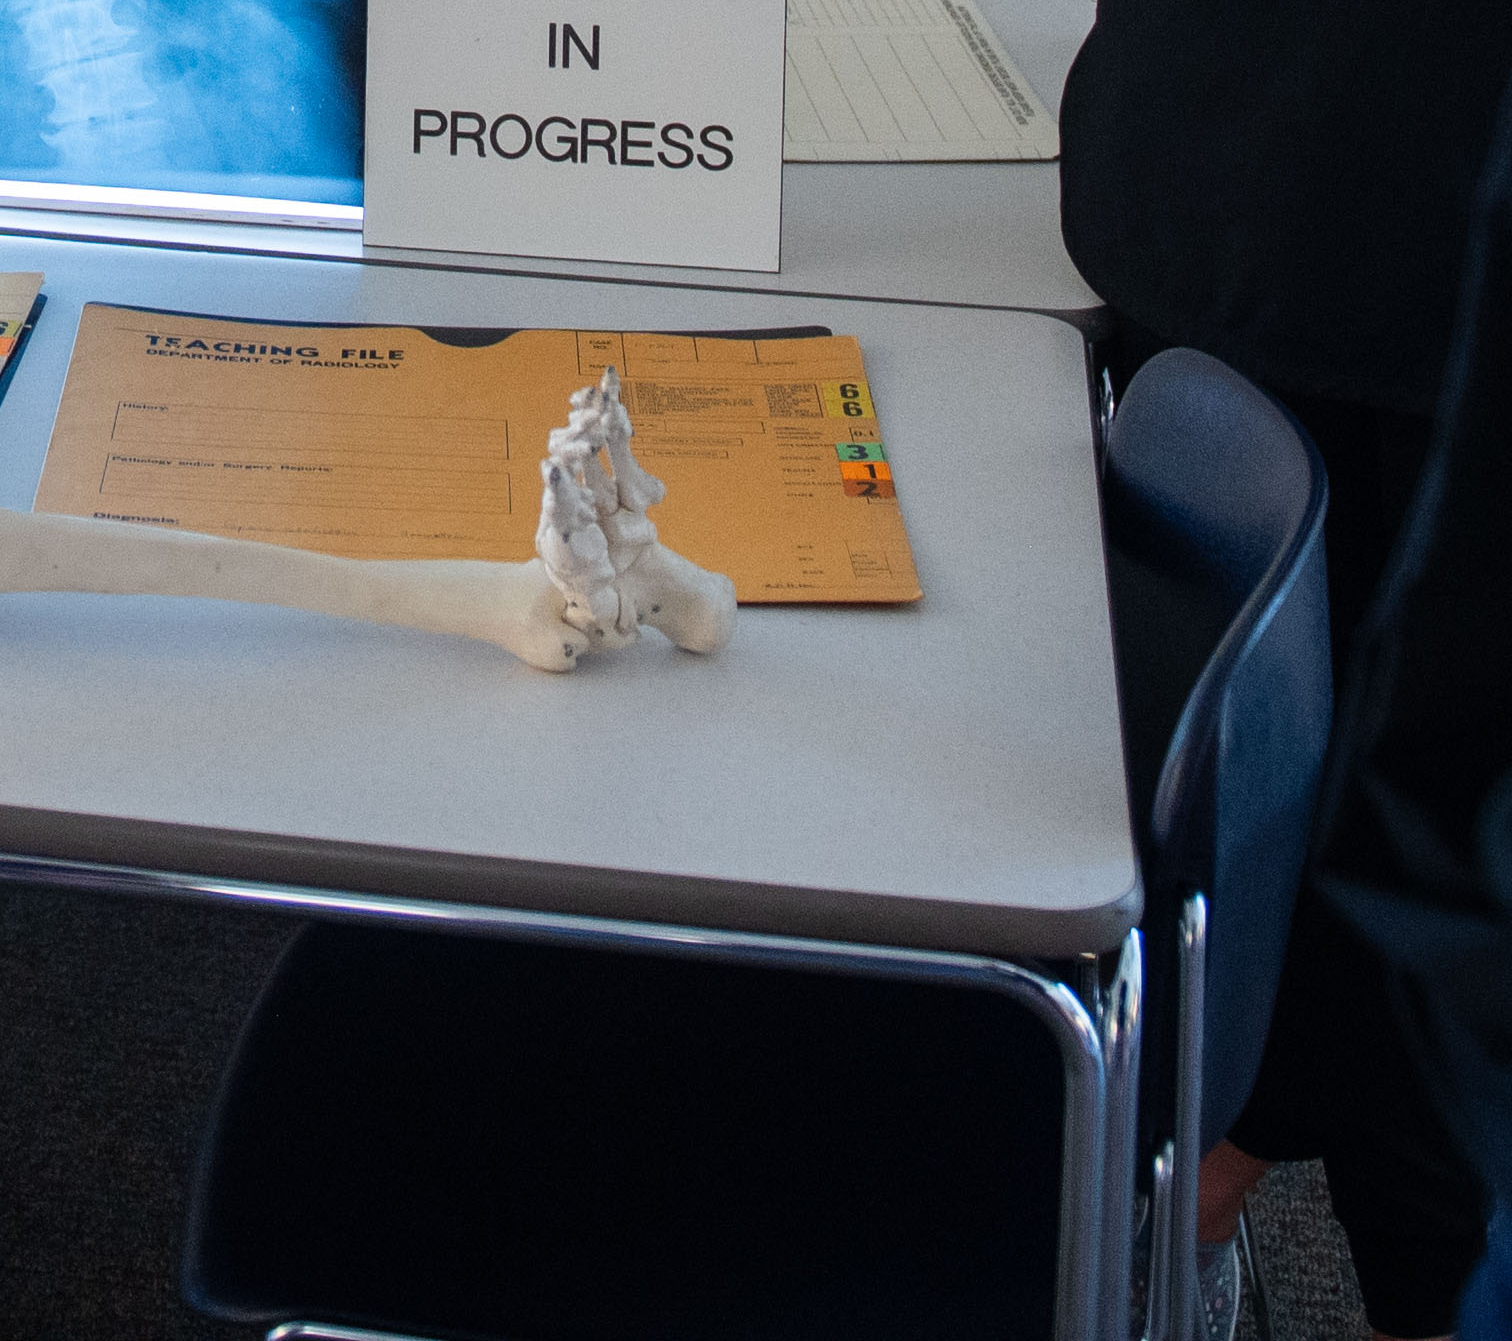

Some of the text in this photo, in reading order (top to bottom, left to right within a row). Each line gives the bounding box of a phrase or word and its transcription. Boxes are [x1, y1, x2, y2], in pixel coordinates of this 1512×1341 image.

[548, 23, 601, 70] IN
[413, 108, 735, 173] PROGRESS
[145, 334, 405, 361] TEACHING FILE
[146, 348, 400, 370] DEPARTMENT OF RADIOLOGY
[839, 383, 860, 399] 6
[842, 401, 863, 417] 6
[846, 444, 869, 460] 3
[112, 455, 173, 466] Pathology
[863, 463, 877, 479] 1
[856, 481, 881, 497] 2
